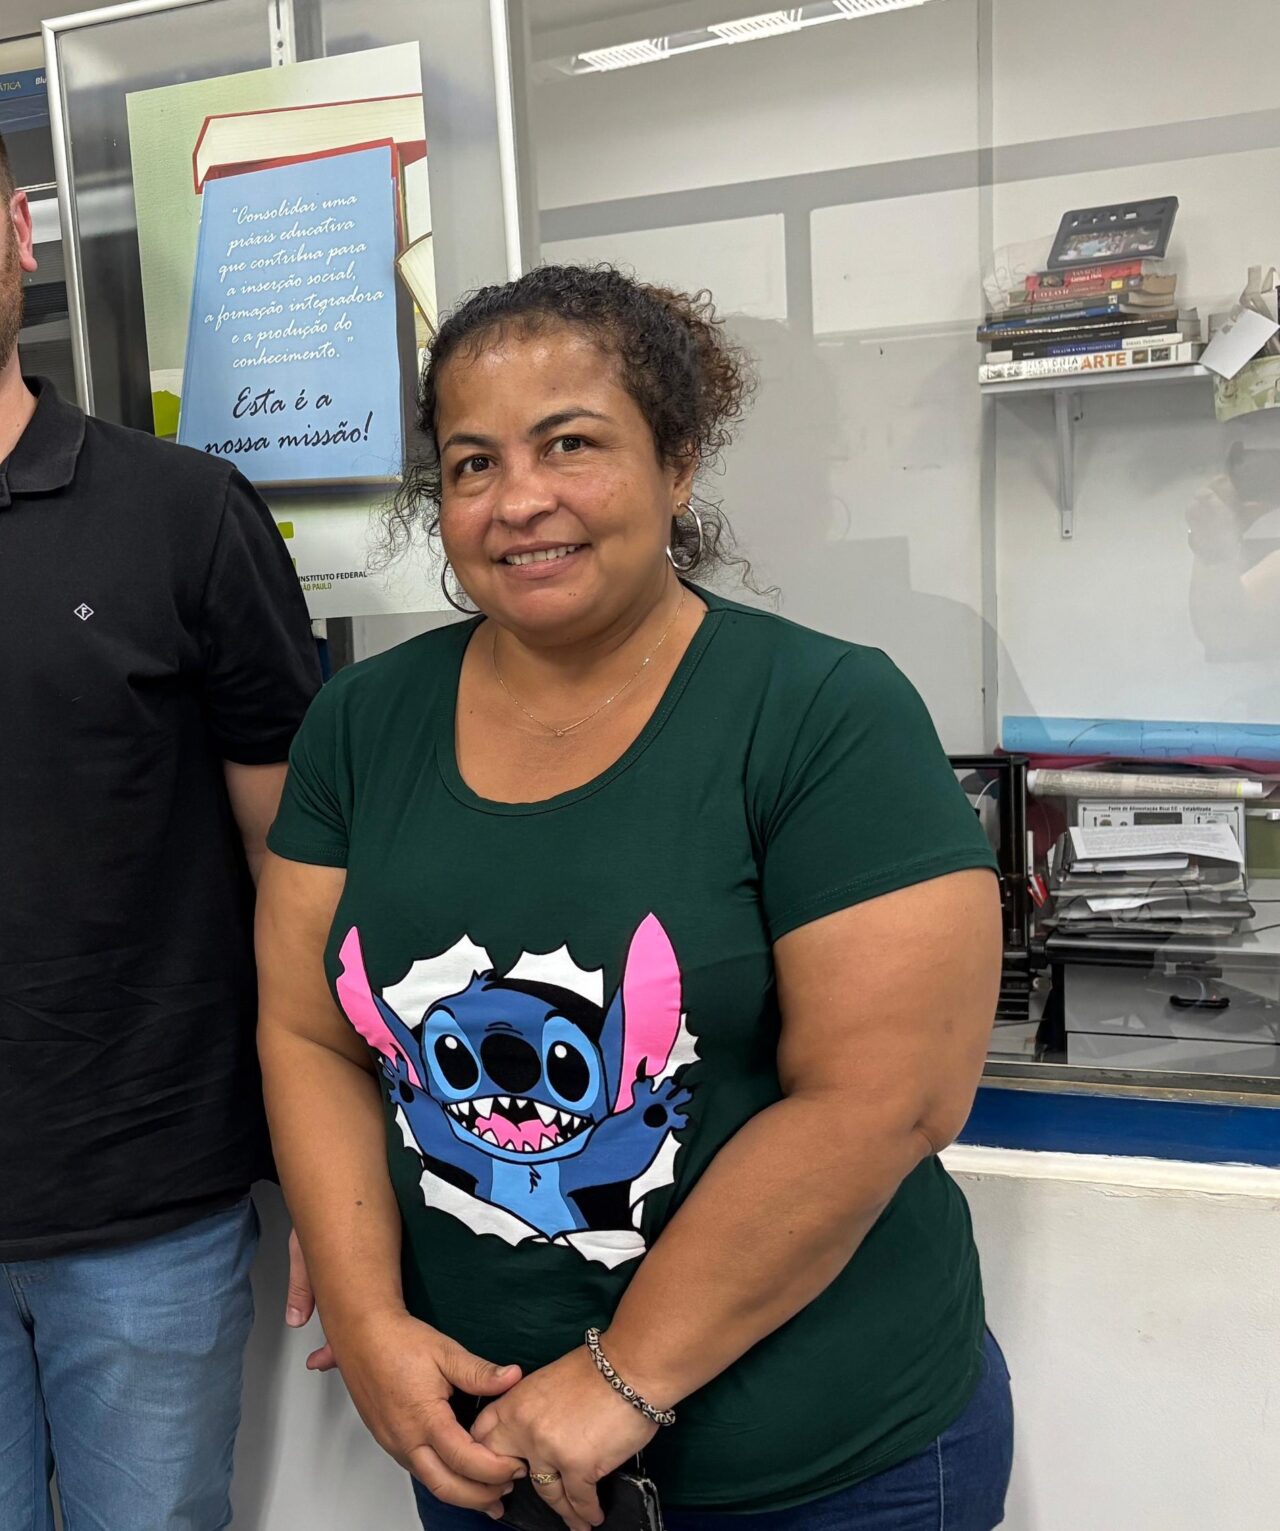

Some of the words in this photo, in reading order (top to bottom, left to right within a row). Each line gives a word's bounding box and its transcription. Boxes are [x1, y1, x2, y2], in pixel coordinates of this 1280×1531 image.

[322, 196, 357, 208] uma
[227, 230, 276, 256] práxis
[280, 217, 355, 240] educativa
[219, 262, 247, 282] que
[250, 243, 324, 269] contribua
[326, 242, 367, 265] para
[226, 287, 236, 296] a
[240, 274, 302, 294] inserção
[306, 261, 356, 286] social,
[204, 314, 214, 323] a
[215, 301, 283, 331] formação
[288, 286, 384, 315] integradora
[231, 334, 239, 344] e
[243, 333, 253, 343] a
[255, 319, 328, 348] produção
[333, 312, 352, 331] do
[233, 342, 339, 368] conhecimento.
[1081, 352, 1126, 370] ARTE
[233, 386, 286, 418] Esta
[295, 389, 308, 410] é
[315, 394, 332, 409] a
[204, 436, 270, 454] nossa
[278, 411, 373, 448] missão!
[298, 574, 335, 582] INSTITUTO
[336, 571, 368, 580] FEDERAL
[312, 582, 332, 590] PAULO
